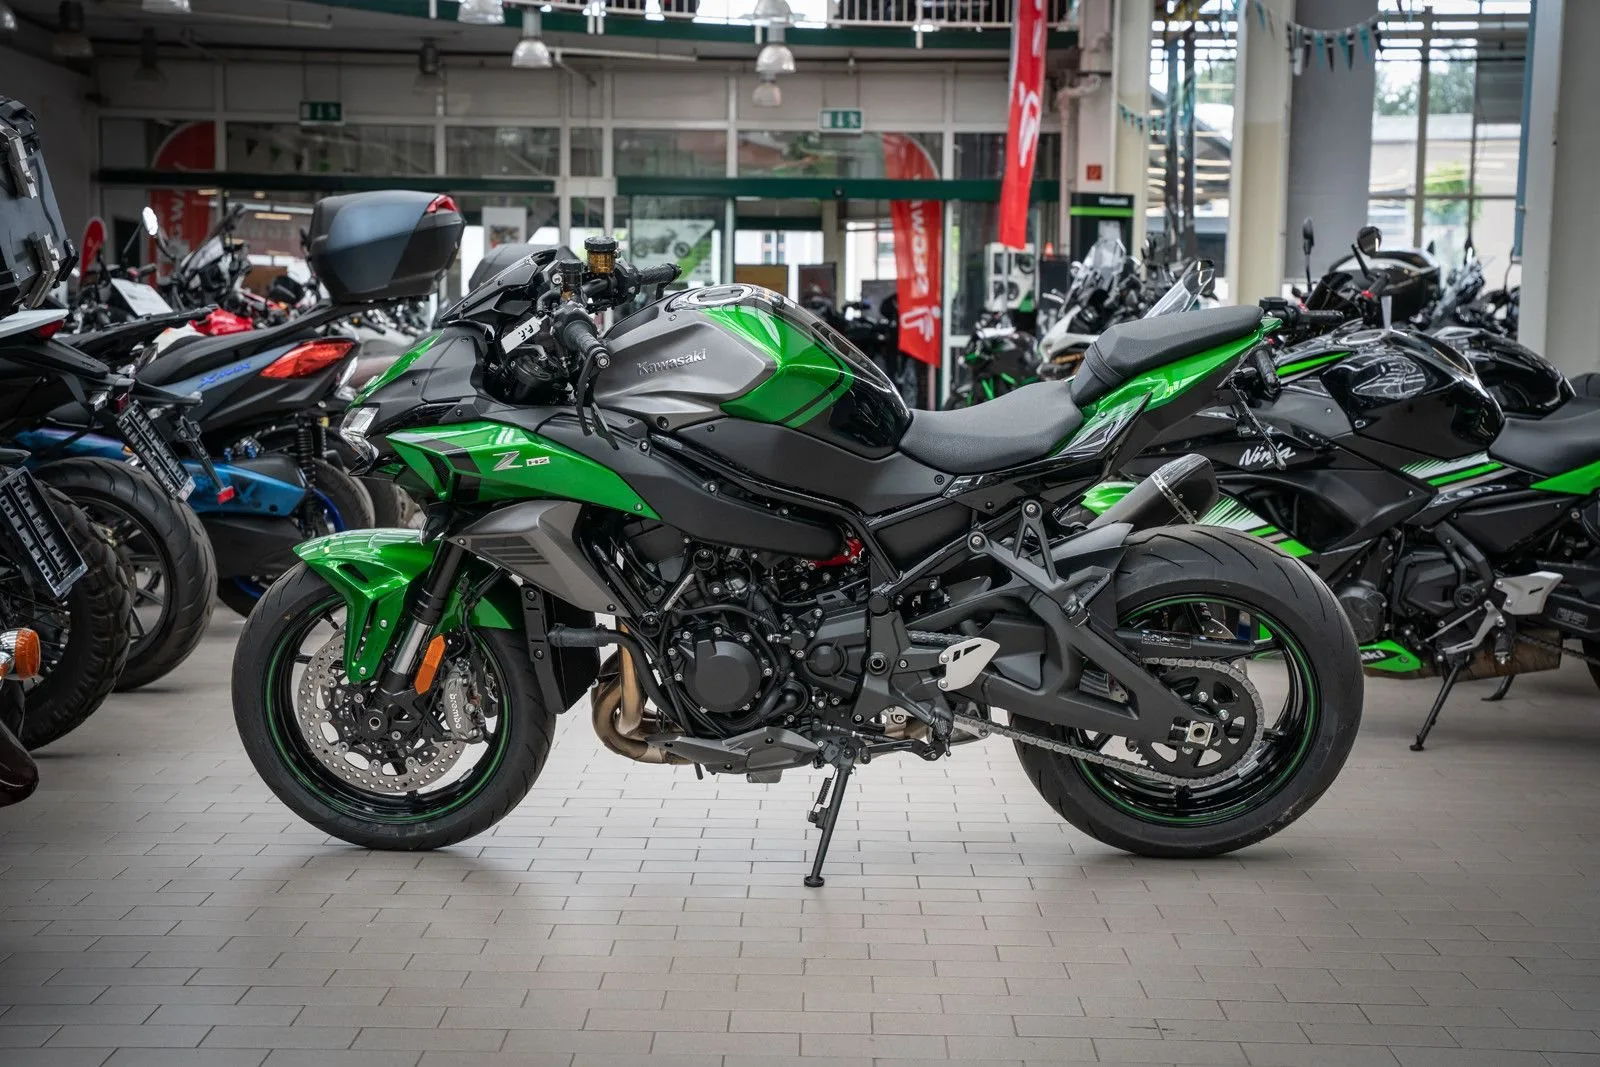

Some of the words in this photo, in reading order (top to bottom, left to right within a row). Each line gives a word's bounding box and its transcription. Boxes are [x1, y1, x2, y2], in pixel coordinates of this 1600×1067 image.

[636, 347, 707, 377] Kawasaki
[492, 450, 523, 472] Z
[526, 456, 550, 467] H2
[1239, 442, 1297, 468] Ninja
[449, 693, 462, 729] brembo
